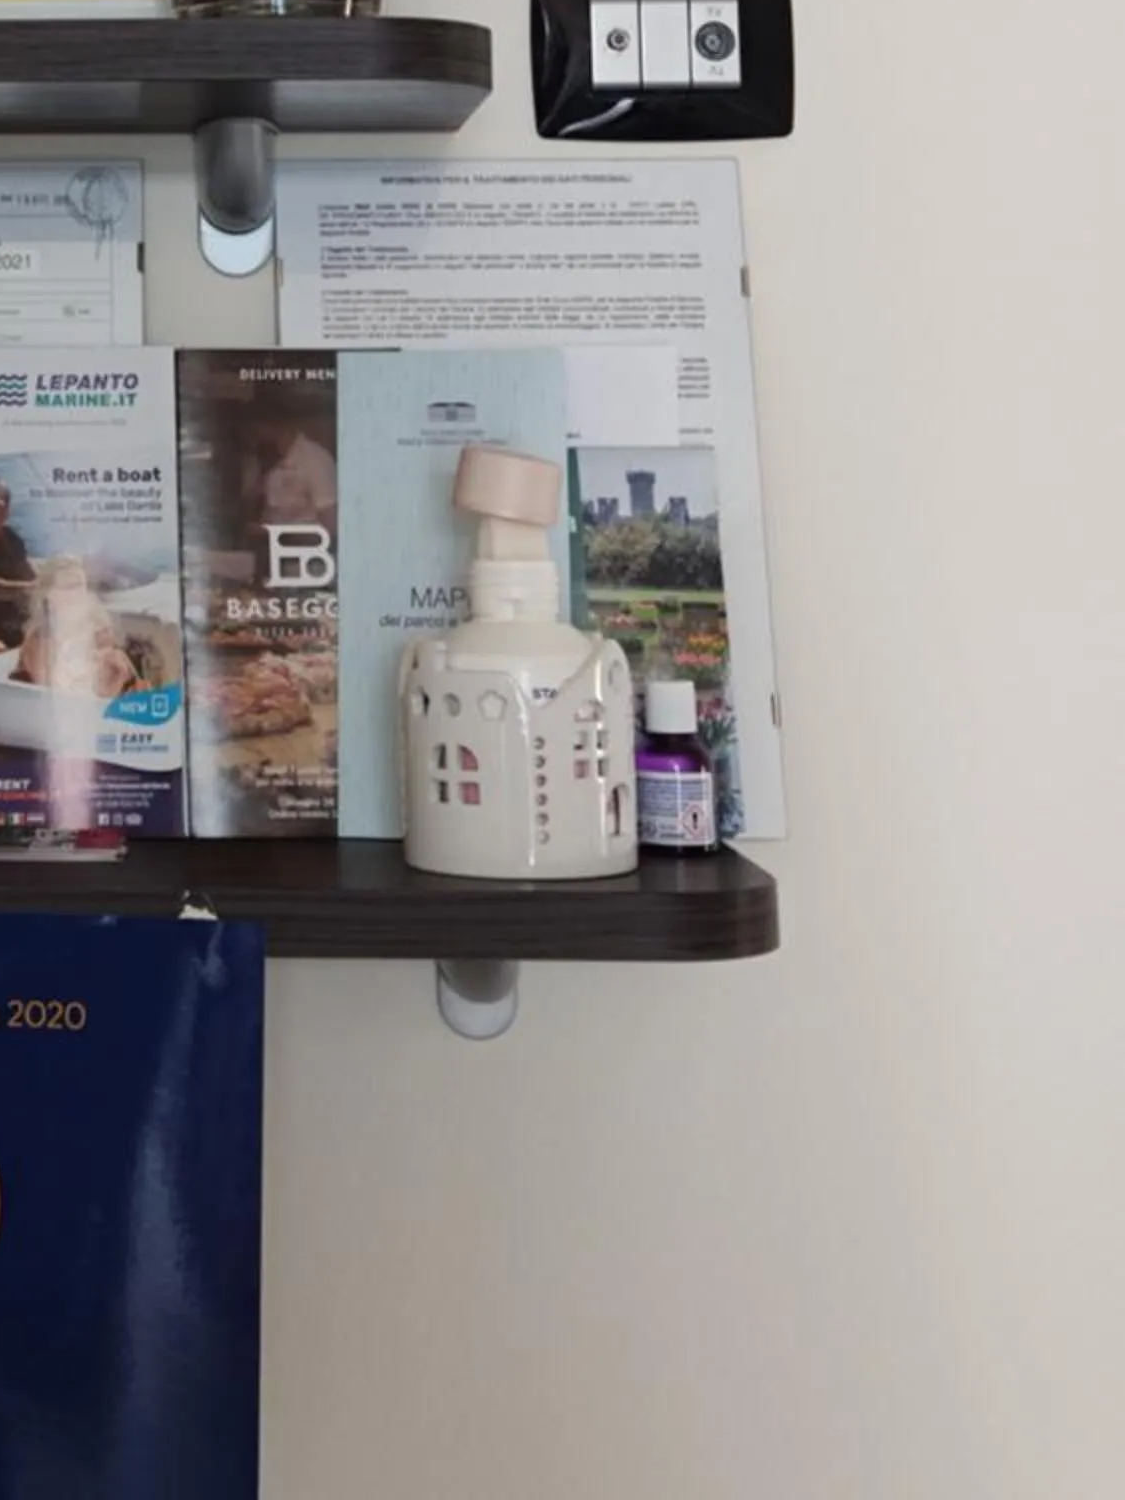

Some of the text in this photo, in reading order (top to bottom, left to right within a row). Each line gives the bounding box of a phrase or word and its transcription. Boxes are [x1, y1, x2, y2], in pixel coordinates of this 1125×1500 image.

[35, 372, 140, 391] LEPANTO
[239, 367, 337, 381] DELIVERY MEN
[34, 392, 139, 409] MARINE.IT
[51, 466, 162, 483] Rent a boat
[119, 702, 148, 713] NEW
[6, 999, 88, 1031] 2020
